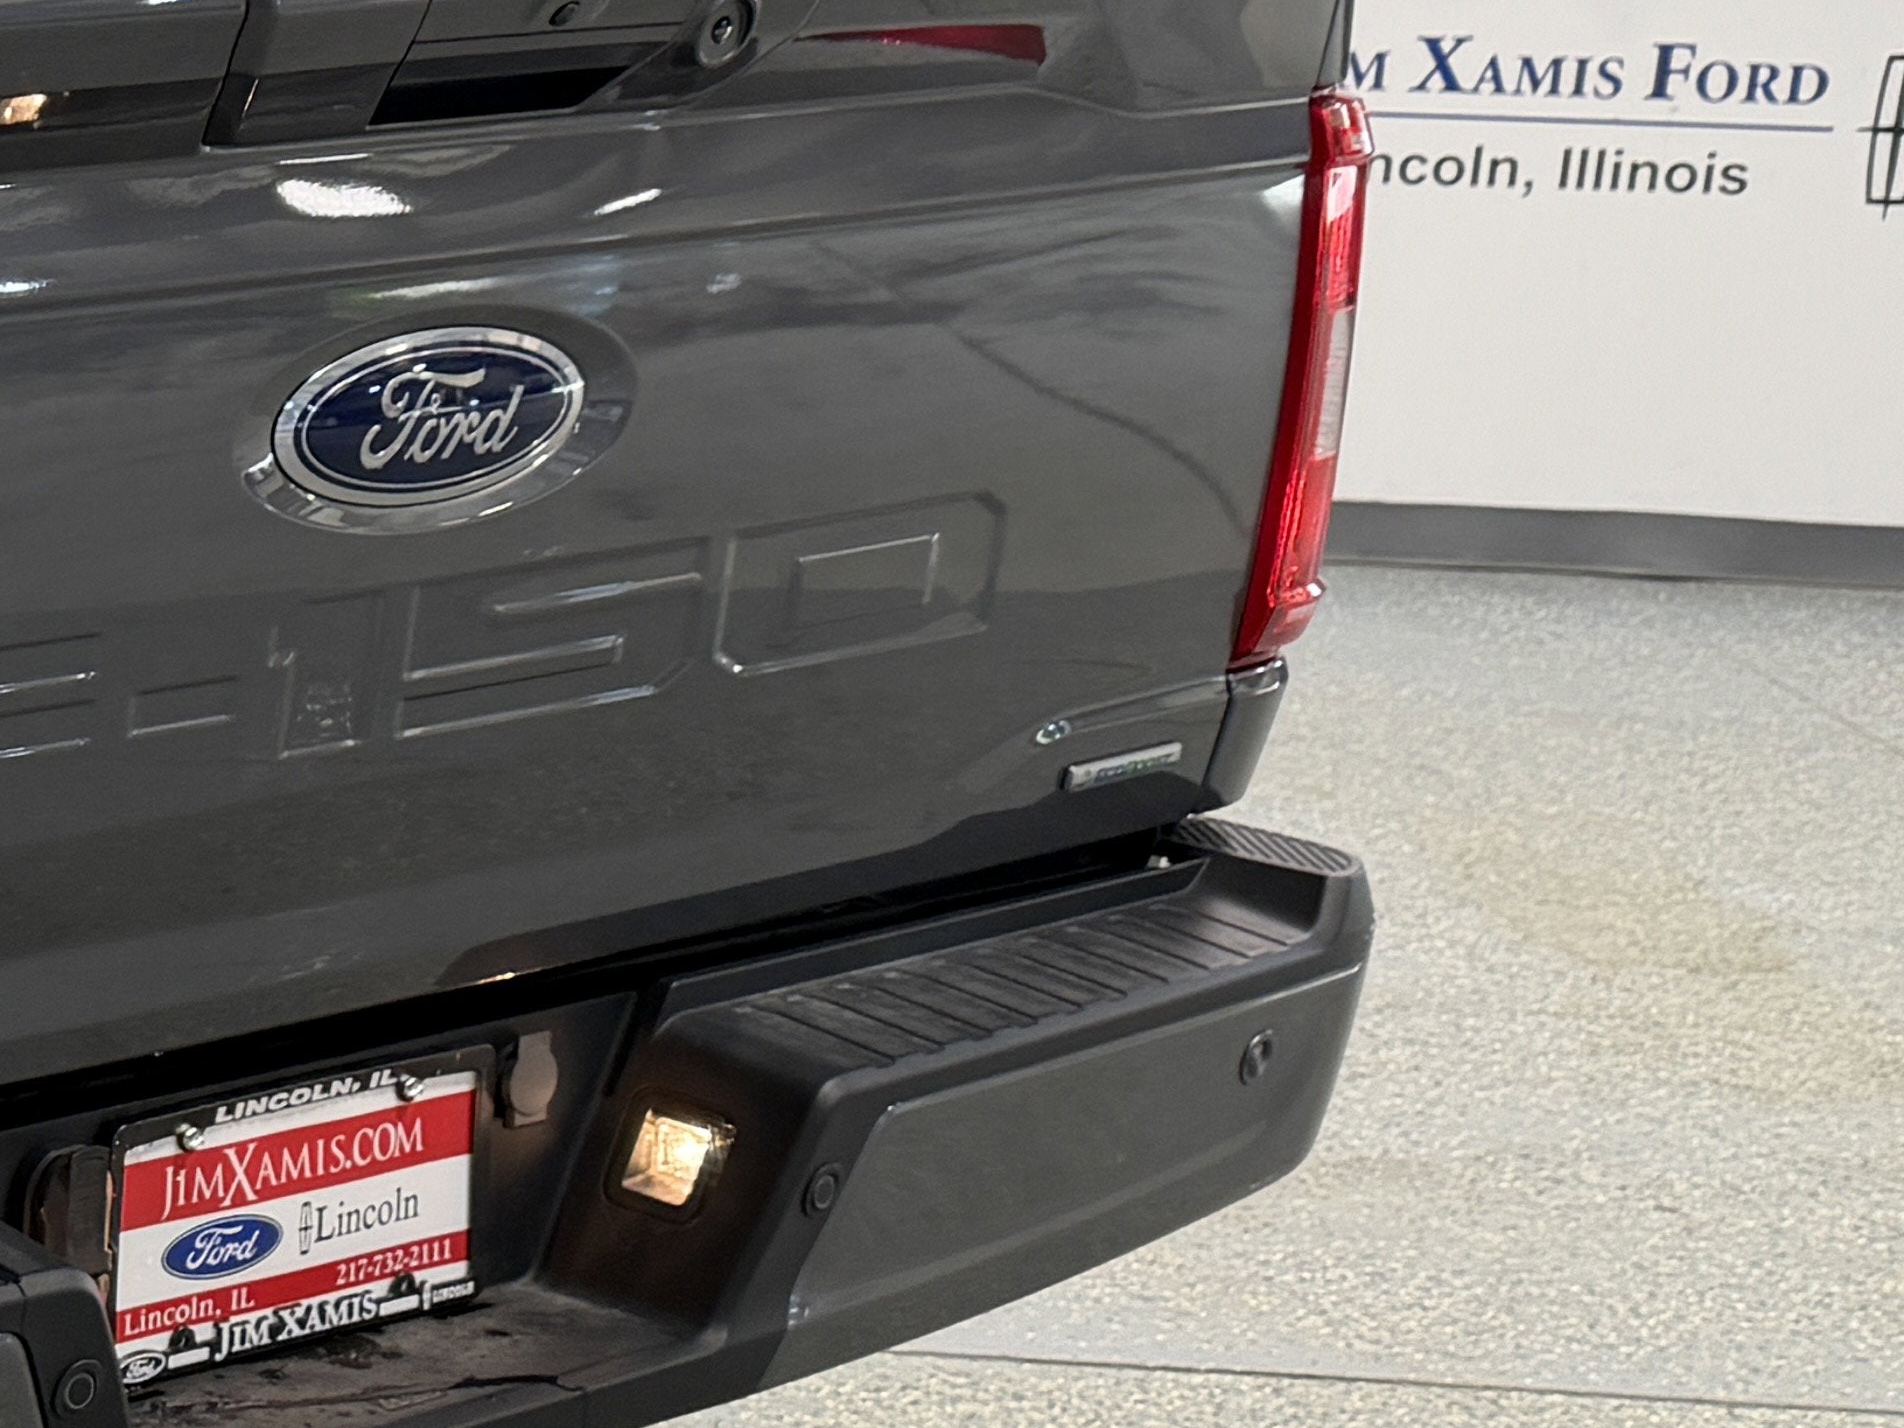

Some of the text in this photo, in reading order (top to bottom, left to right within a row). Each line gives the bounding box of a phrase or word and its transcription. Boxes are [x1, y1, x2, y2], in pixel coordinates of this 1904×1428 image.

[1409, 34, 1624, 101] XAMIS
[1644, 42, 1830, 106] FORD
[1369, 144, 1749, 197] ncoln, Illinois
[360, 363, 524, 470] Ford
[214, 1068, 398, 1124] LINCOLN, IL
[314, 1187, 419, 1244] Lincoln
[186, 1224, 259, 1269] Ford
[336, 1239, 452, 1286] 217-732-2111
[123, 1286, 255, 1336] Lincoln, IL
[215, 1319, 272, 1362] JIM
[277, 1292, 378, 1341] XAMIS
